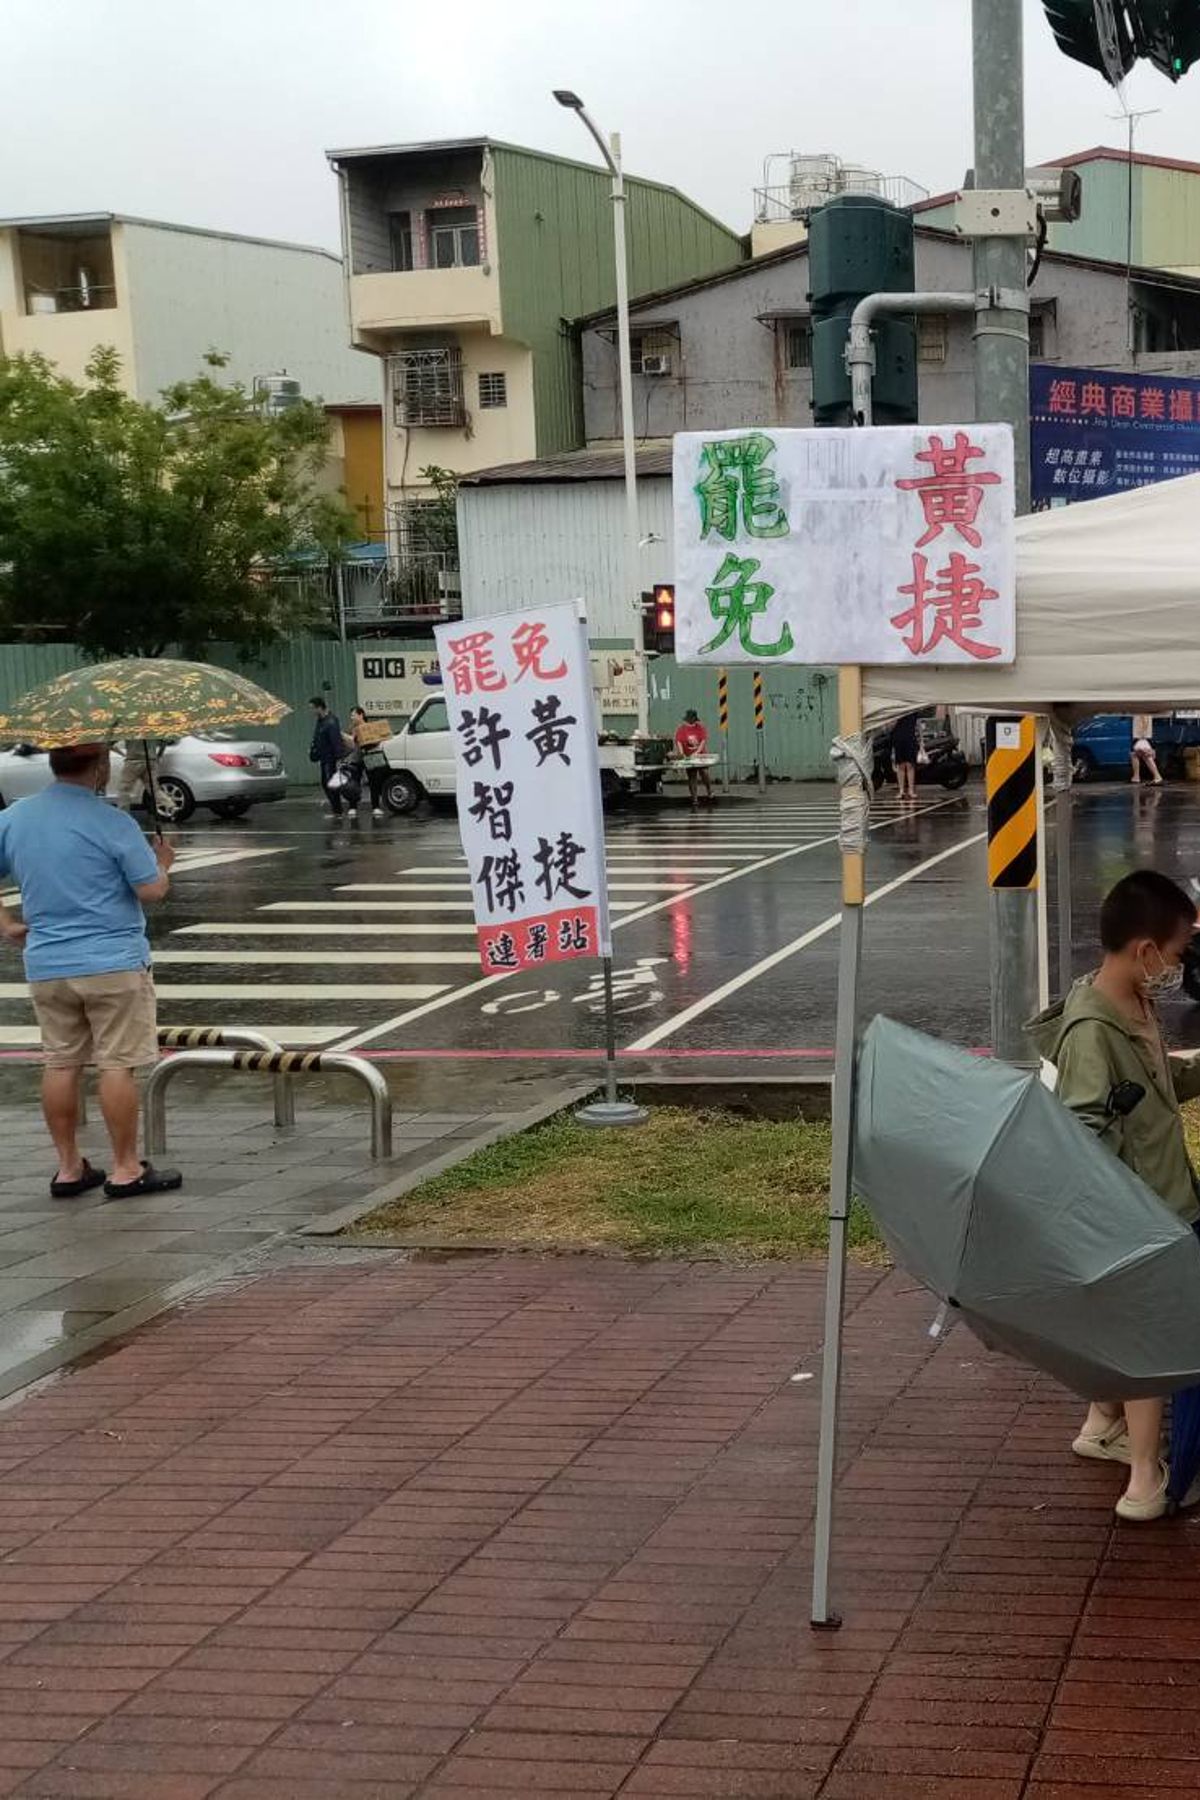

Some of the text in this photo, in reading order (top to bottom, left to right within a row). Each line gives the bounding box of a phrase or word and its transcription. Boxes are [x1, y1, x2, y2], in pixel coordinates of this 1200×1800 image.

[694, 432, 794, 656] 罷免
[890, 431, 1003, 660] 黃捷
[1052, 468, 1111, 486] 數位攝影
[445, 621, 568, 696] 罷免
[456, 705, 526, 914] 許智傑
[524, 694, 592, 902] 黃捷
[486, 919, 590, 968] 連署站
